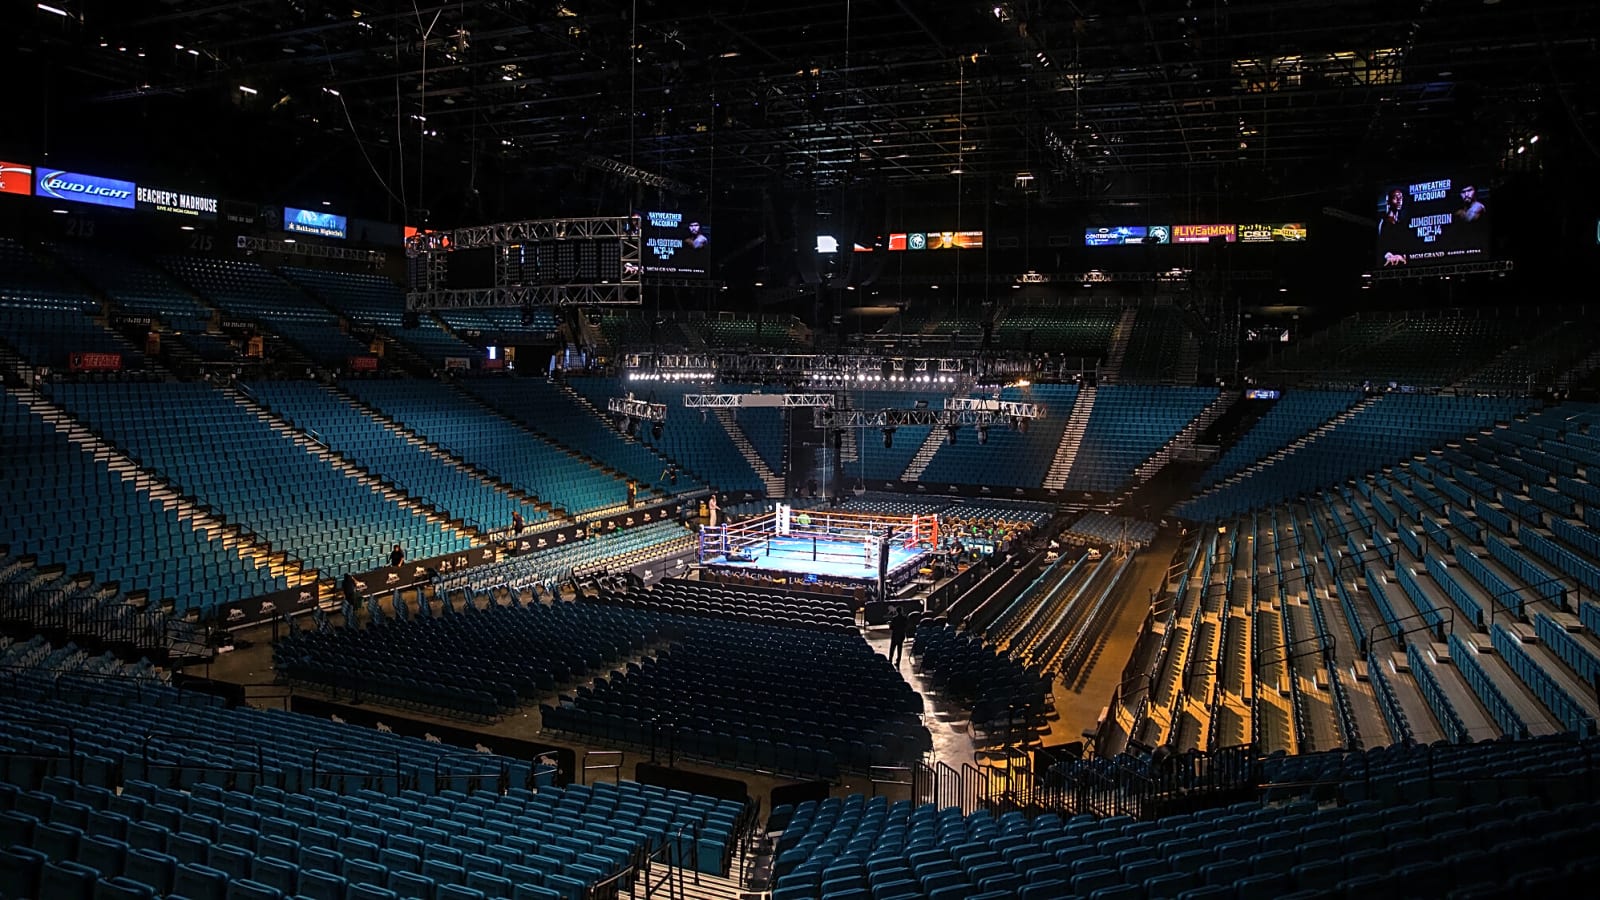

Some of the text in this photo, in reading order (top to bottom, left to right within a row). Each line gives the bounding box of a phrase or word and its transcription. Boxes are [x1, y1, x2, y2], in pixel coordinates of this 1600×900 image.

[48, 179, 131, 200] BUD LIGHT
[1409, 179, 1451, 193] MAYWEATHER
[137, 187, 217, 213] BEACHER'S MADHOUSE
[1414, 190, 1446, 202] PACQUIAO
[1409, 213, 1452, 228] JUMBOTRON
[1174, 225, 1235, 236] #LIVEatMGM
